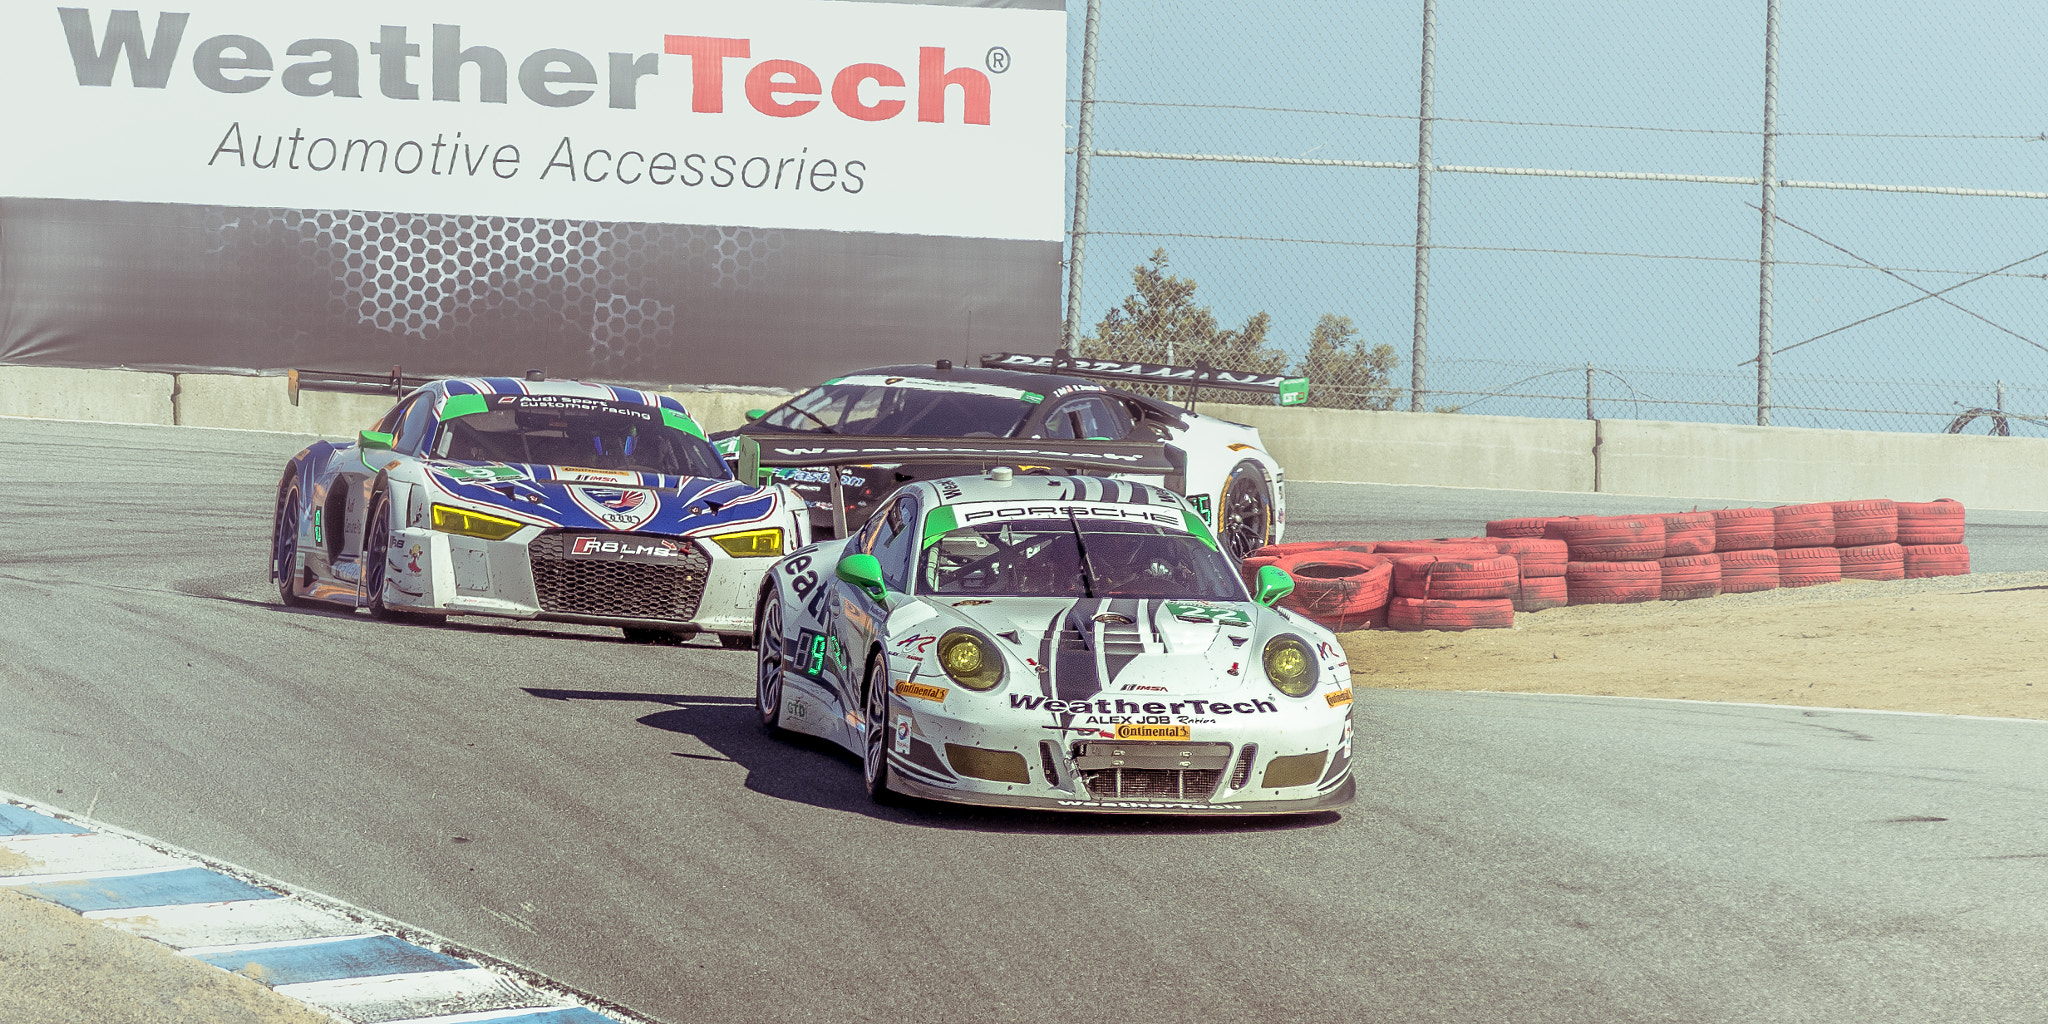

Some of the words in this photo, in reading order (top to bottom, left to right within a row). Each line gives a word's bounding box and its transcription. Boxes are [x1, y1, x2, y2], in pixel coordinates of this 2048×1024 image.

[208, 122, 520, 179] Automotive
[540, 136, 867, 194] Accessories
[563, 397, 608, 406] Sport
[520, 402, 598, 410] customer
[602, 407, 651, 420] racing
[465, 468, 496, 478] 9
[965, 506, 1179, 526] PORSCHE
[1178, 605, 1242, 620] 22
[895, 681, 940, 697] Continental
[1136, 684, 1169, 693] IMSA
[1009, 693, 1278, 715] WeatherTech
[1086, 715, 1131, 725] ALEX
[1136, 715, 1171, 725] JOB
[1118, 726, 1179, 738] Continental
[1058, 800, 1243, 810] WeatherTech
